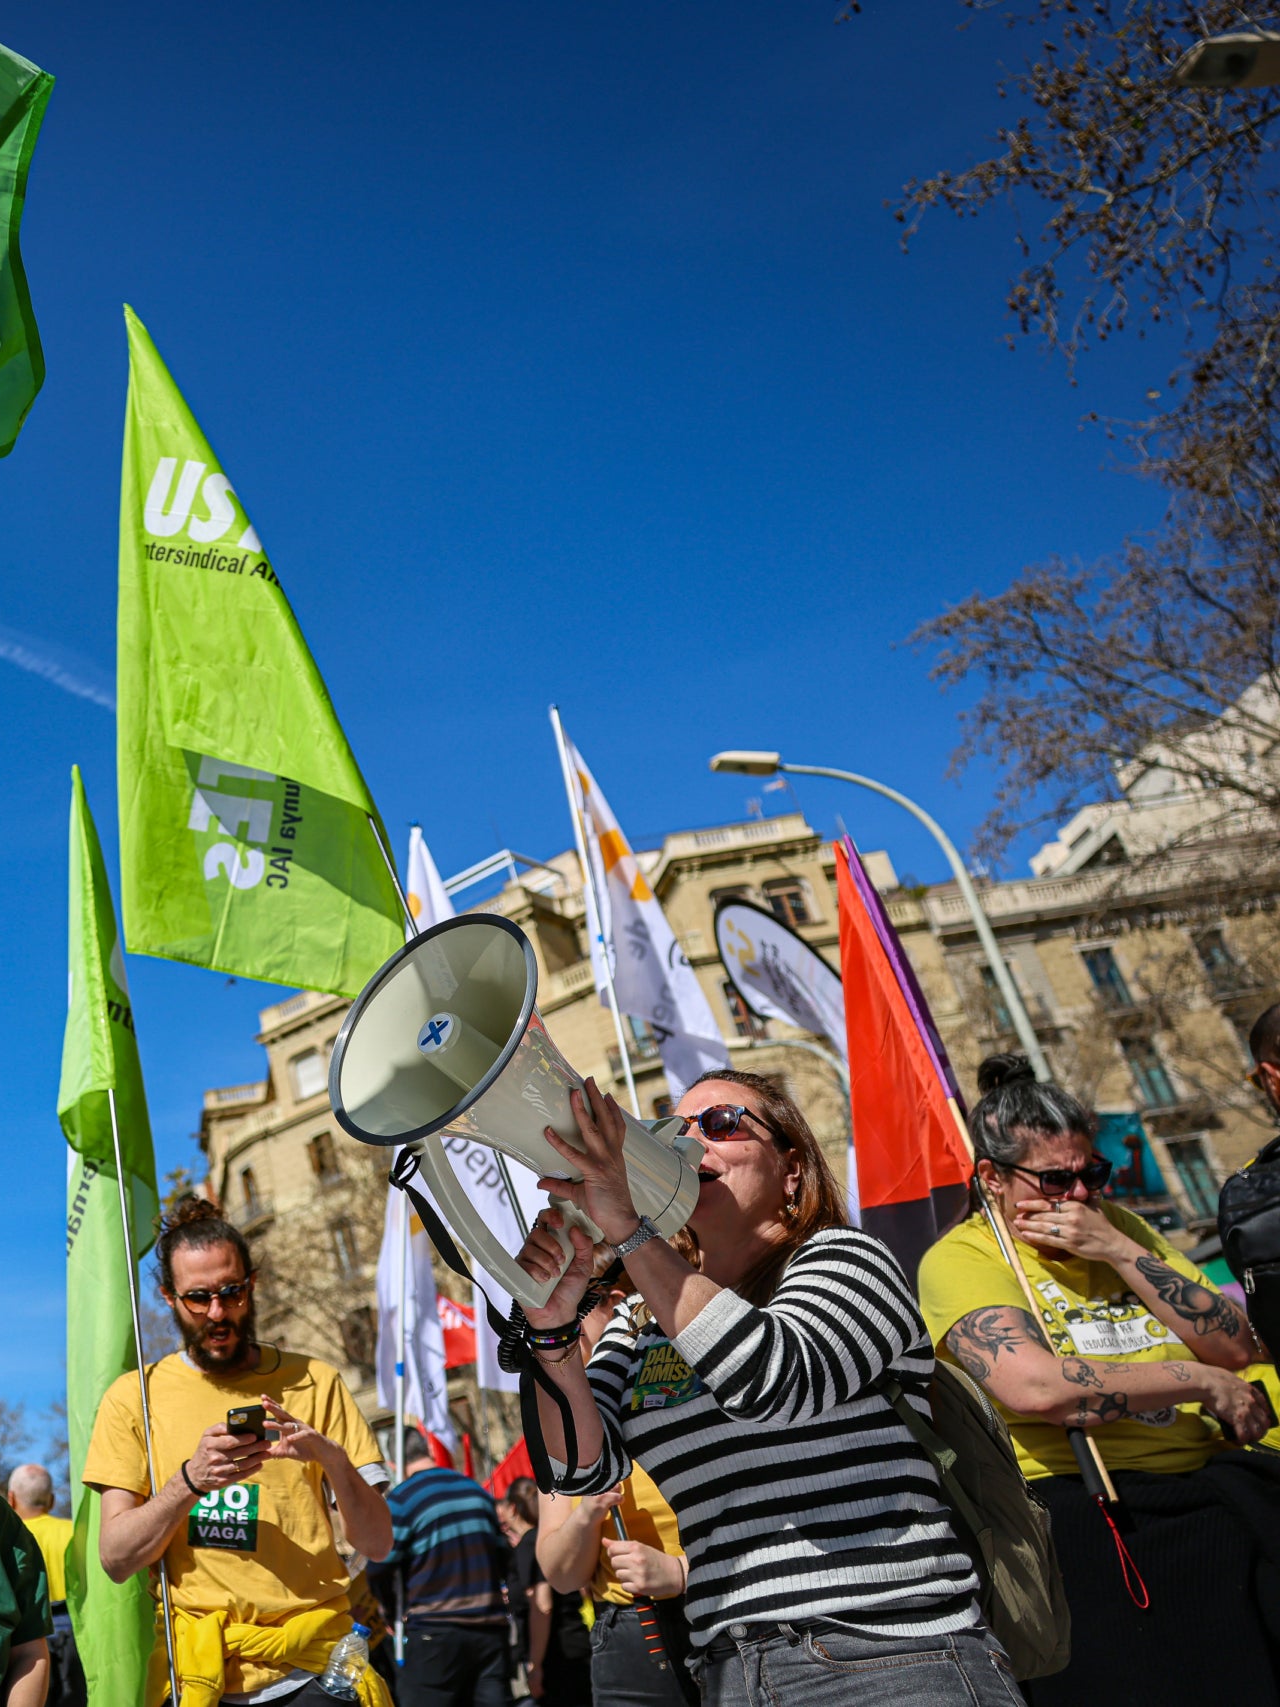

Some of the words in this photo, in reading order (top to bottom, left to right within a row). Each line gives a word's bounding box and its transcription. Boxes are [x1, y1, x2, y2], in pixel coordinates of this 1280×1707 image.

[199, 1485, 250, 1510] JO
[197, 1508, 250, 1525] FARÉ
[197, 1525, 248, 1541] VAGA
